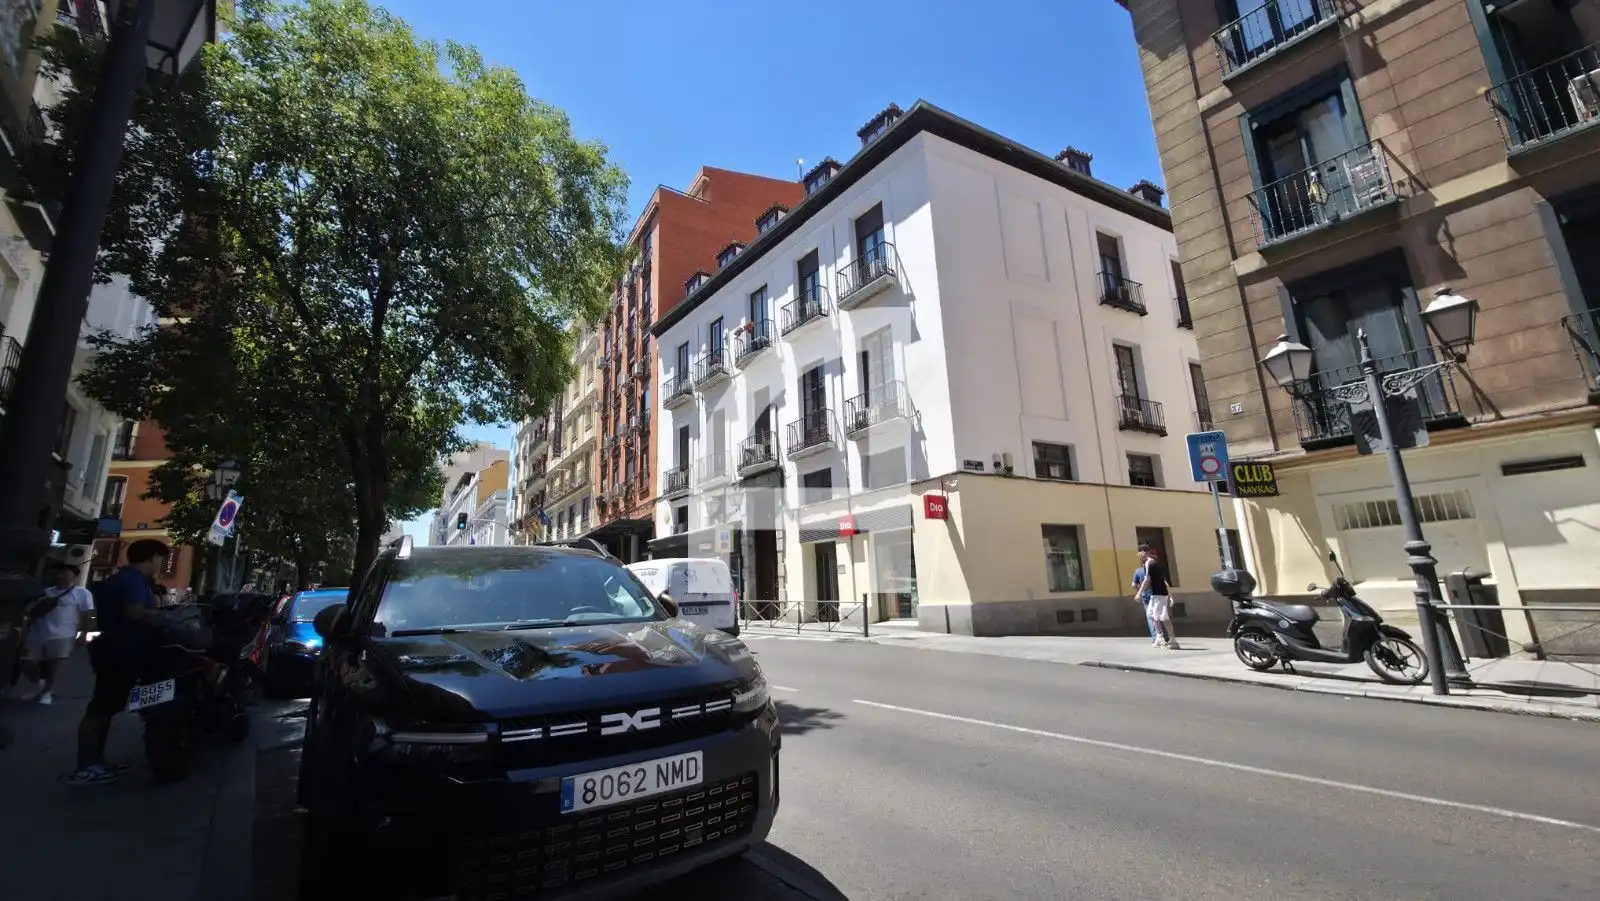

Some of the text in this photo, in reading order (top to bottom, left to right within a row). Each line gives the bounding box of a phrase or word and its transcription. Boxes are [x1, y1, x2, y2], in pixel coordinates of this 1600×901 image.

[1234, 464, 1273, 482] CLUB
[141, 681, 172, 697] 6055
[582, 757, 698, 804] 8062 NMD
